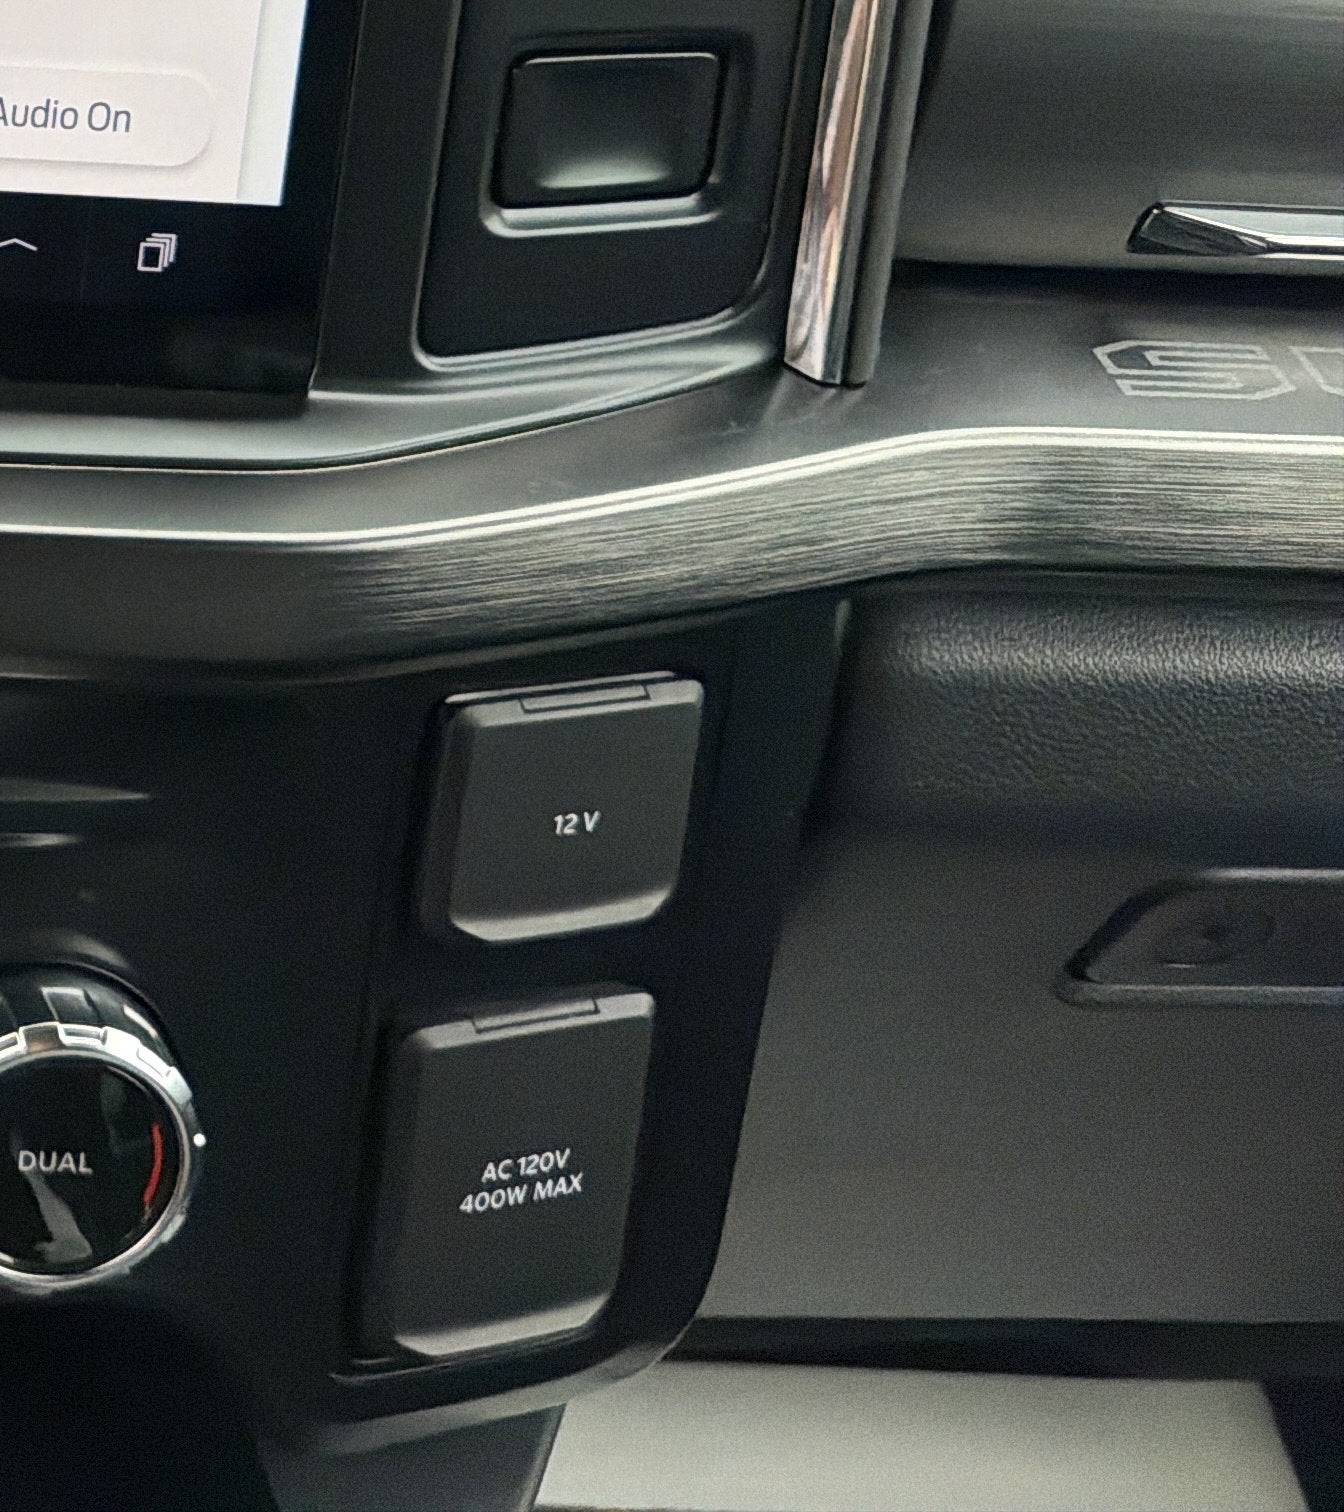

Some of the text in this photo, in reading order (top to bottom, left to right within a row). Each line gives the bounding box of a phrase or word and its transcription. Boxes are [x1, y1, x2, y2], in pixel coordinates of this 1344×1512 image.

[87, 102, 131, 134] On
[554, 810, 601, 834] 12 V
[18, 1149, 94, 1175] DUAL
[481, 1147, 571, 1183] AC 120V
[459, 1171, 583, 1214] 400W MAX
